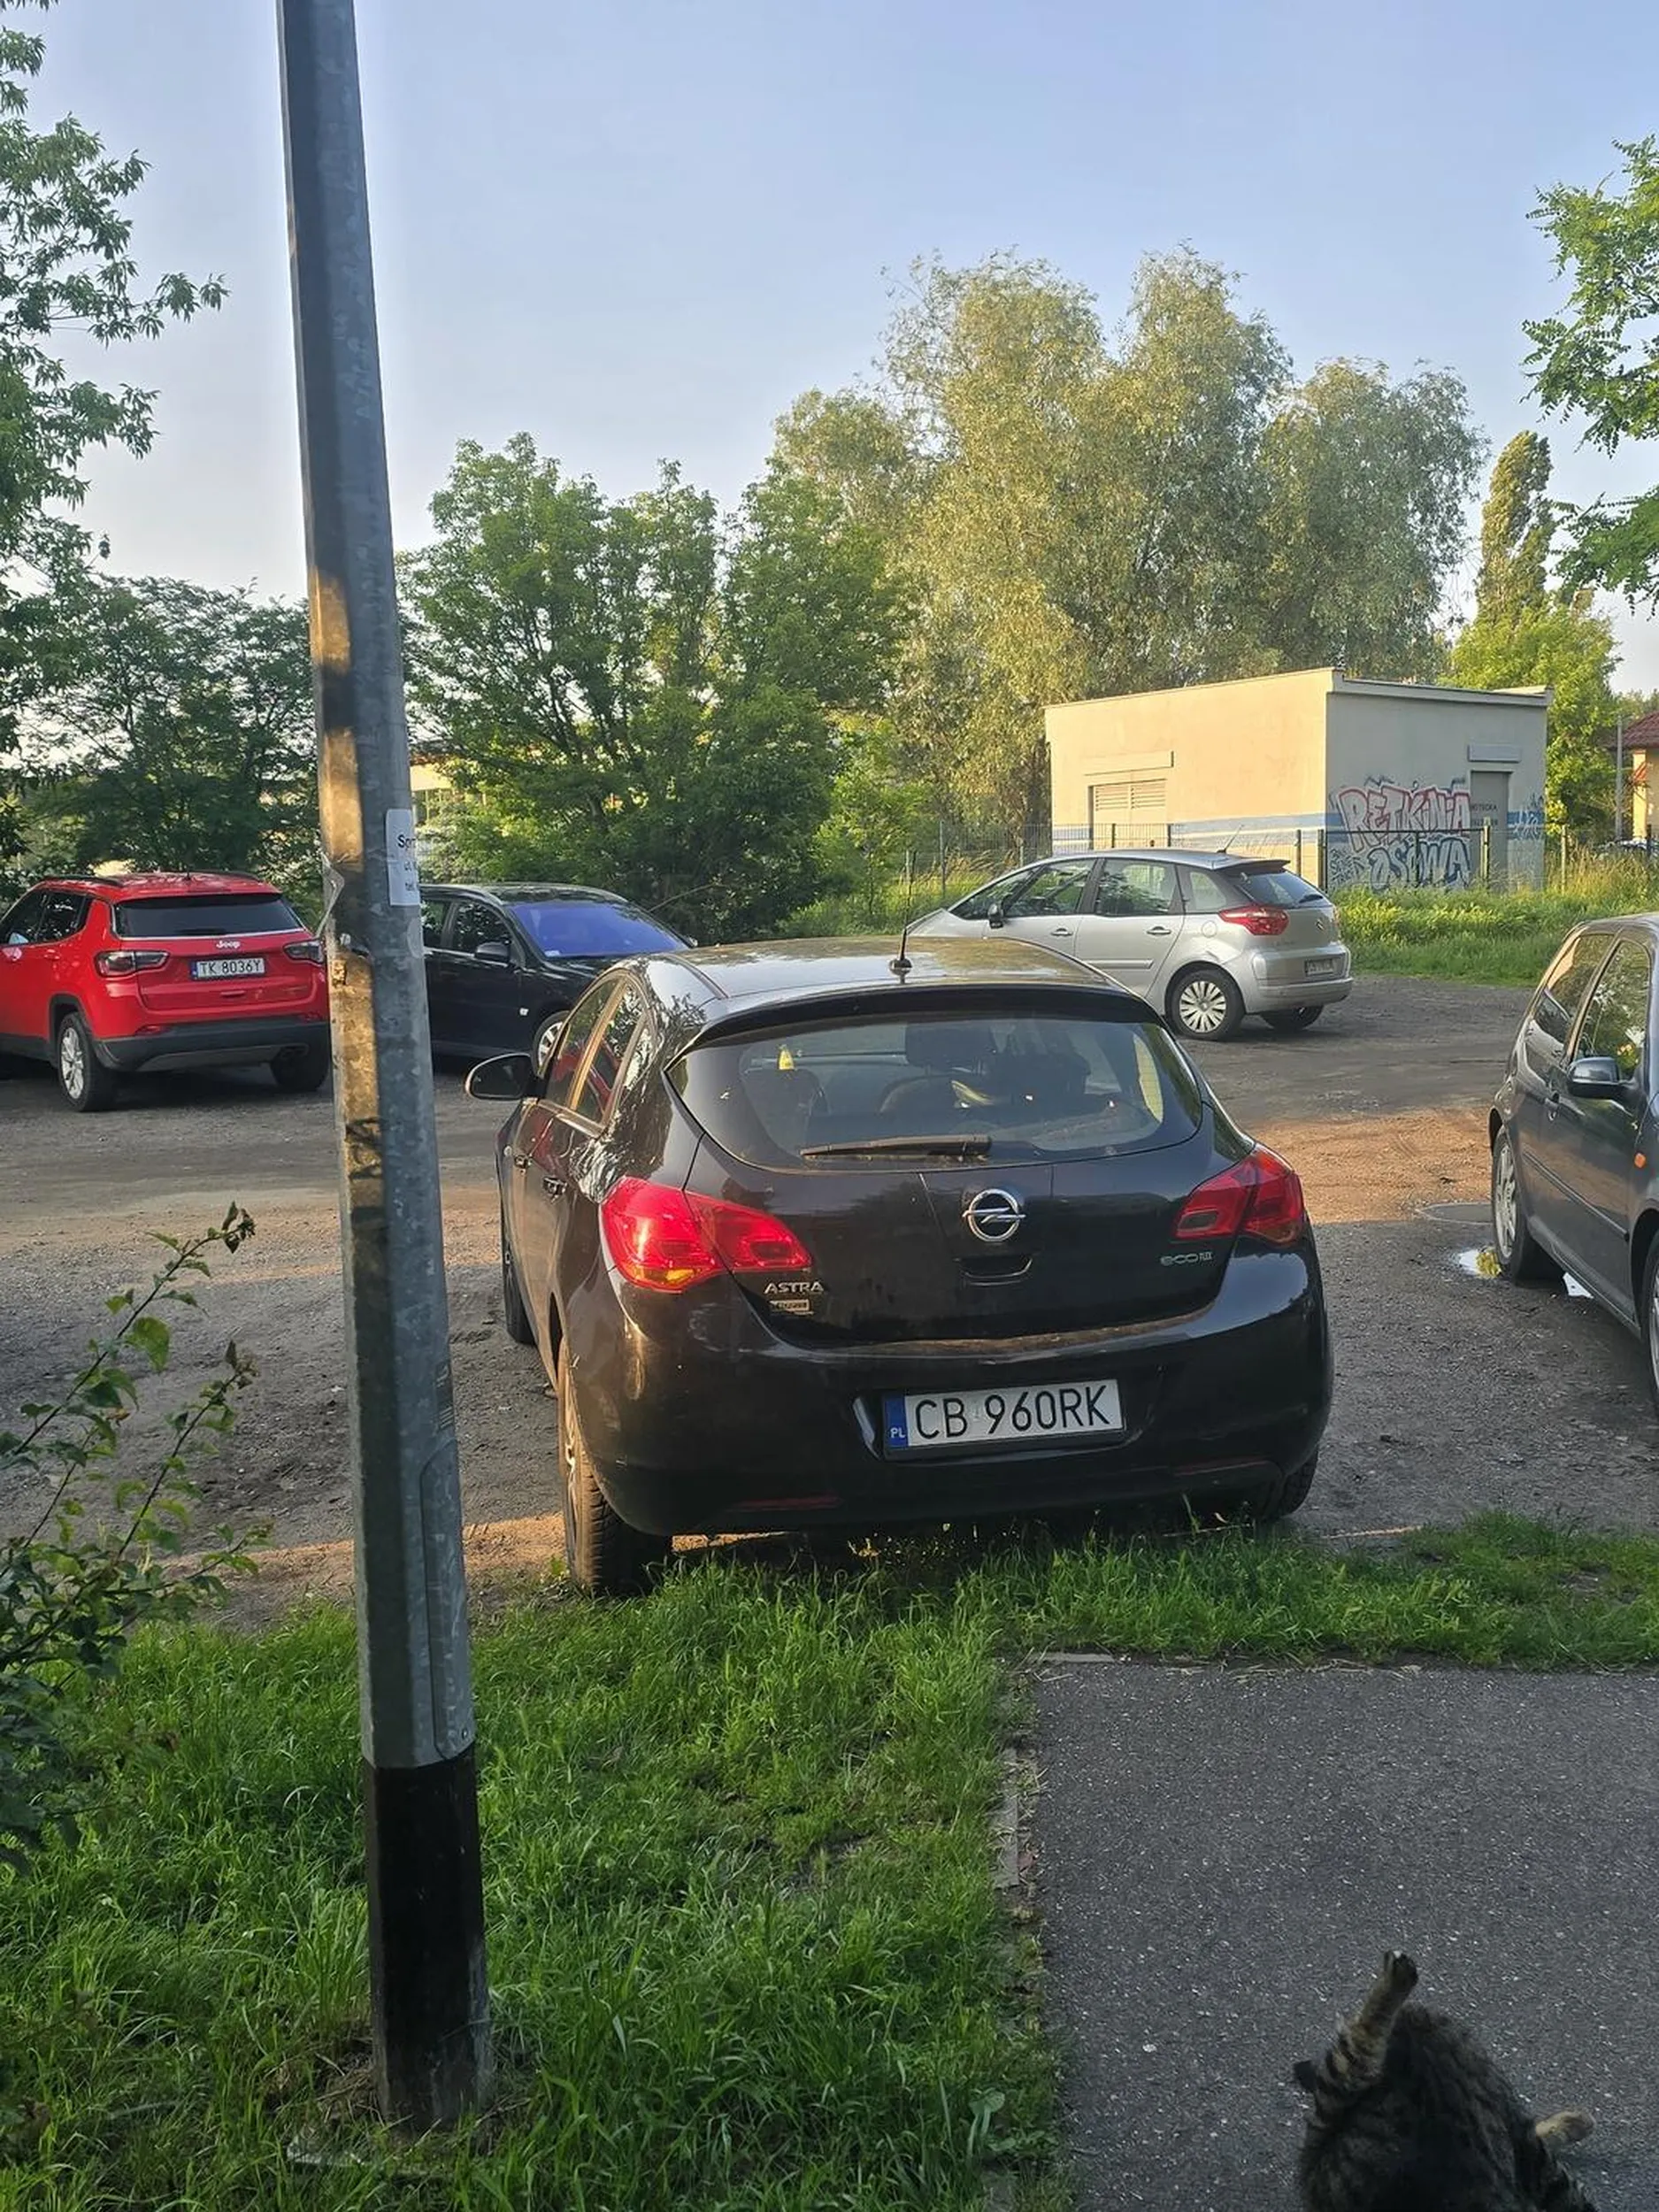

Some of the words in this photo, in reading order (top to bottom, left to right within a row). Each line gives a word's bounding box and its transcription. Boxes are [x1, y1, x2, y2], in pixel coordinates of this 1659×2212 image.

[216, 940, 241, 950] Jeep
[200, 962, 217, 976] TK
[222, 959, 261, 974] 8036Y
[764, 1281, 824, 1294] ASTRA
[915, 1398, 968, 1440] CB
[984, 1384, 1111, 1434] 960RK
[890, 1426, 906, 1439] PL
